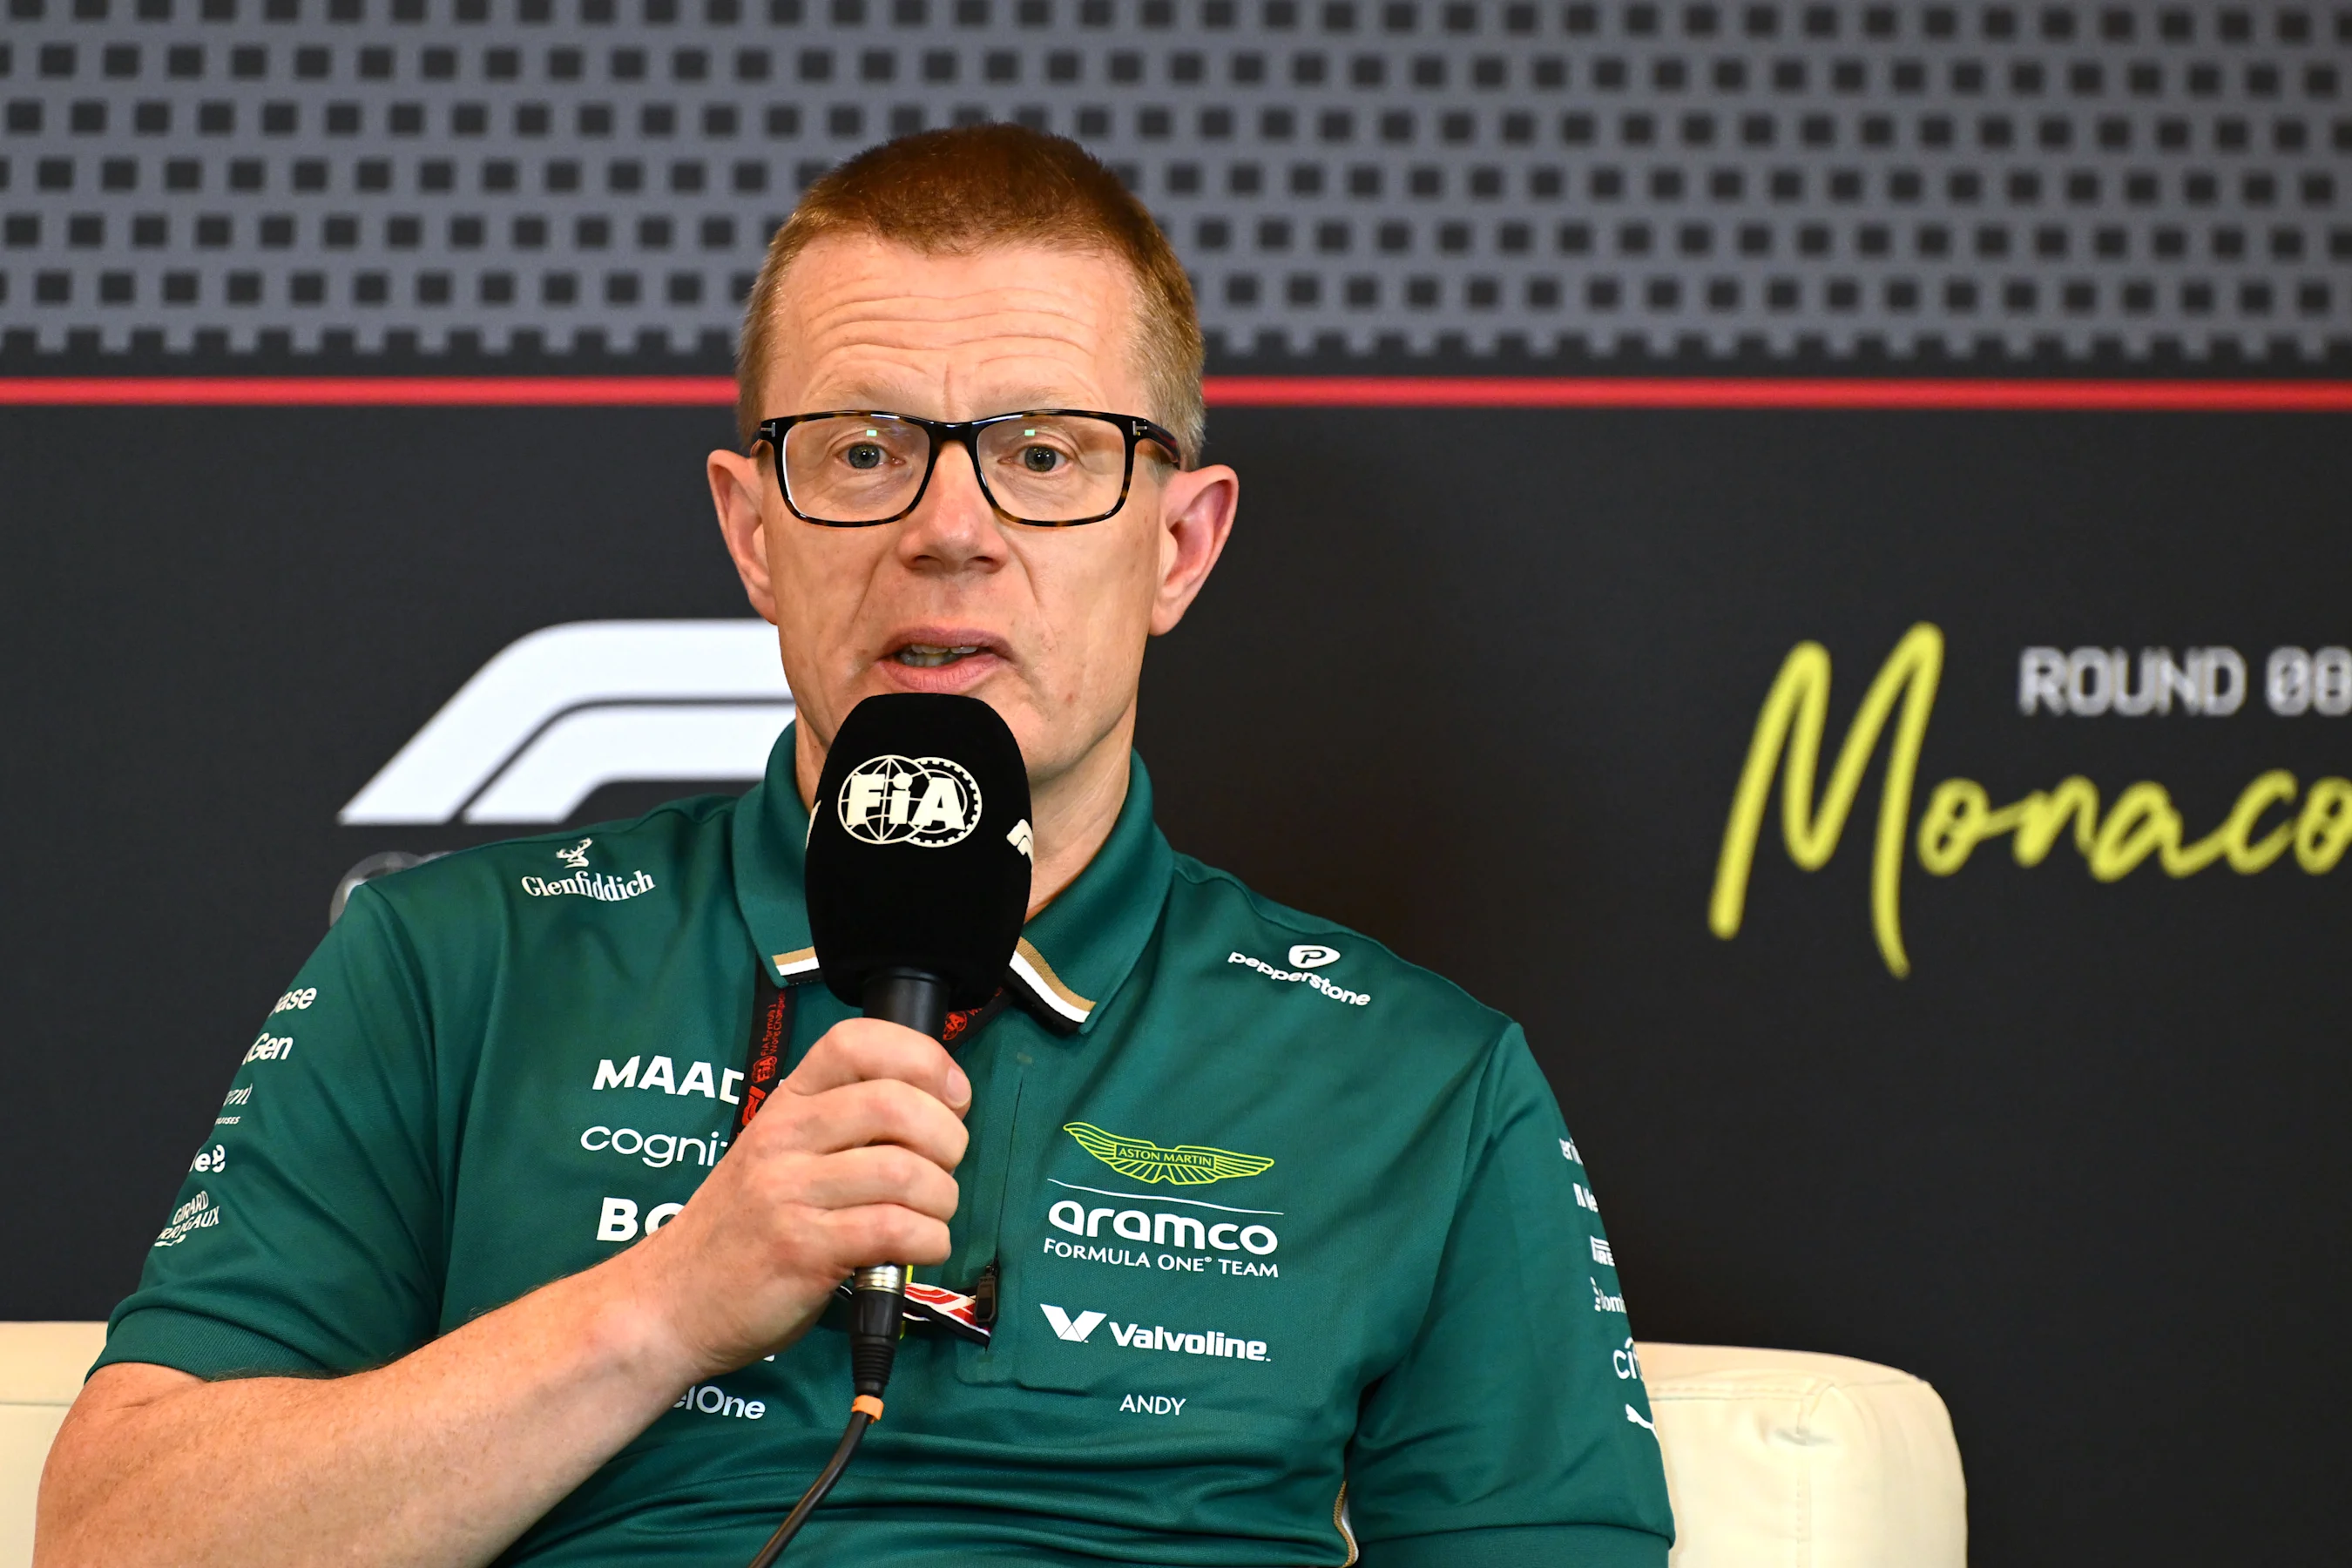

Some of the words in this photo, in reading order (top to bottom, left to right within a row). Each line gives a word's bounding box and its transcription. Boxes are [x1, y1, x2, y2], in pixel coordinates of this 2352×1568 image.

[2018, 645, 2247, 716] ROUND
[1708, 621, 2352, 979] Monaco
[521, 870, 656, 902] Glenfiddich
[1227, 951, 1371, 1006] pepperstone
[268, 987, 317, 1017] ase
[241, 1032, 294, 1065] Gen
[1119, 1147, 1160, 1161] ASTON
[1163, 1152, 1212, 1167] MARTIN
[172, 1190, 209, 1226] GIRARD
[1048, 1200, 1278, 1255] aramco
[1043, 1237, 1151, 1268] FORMULA
[1217, 1258, 1279, 1278] TEAM
[1119, 1394, 1186, 1416] ANDY
